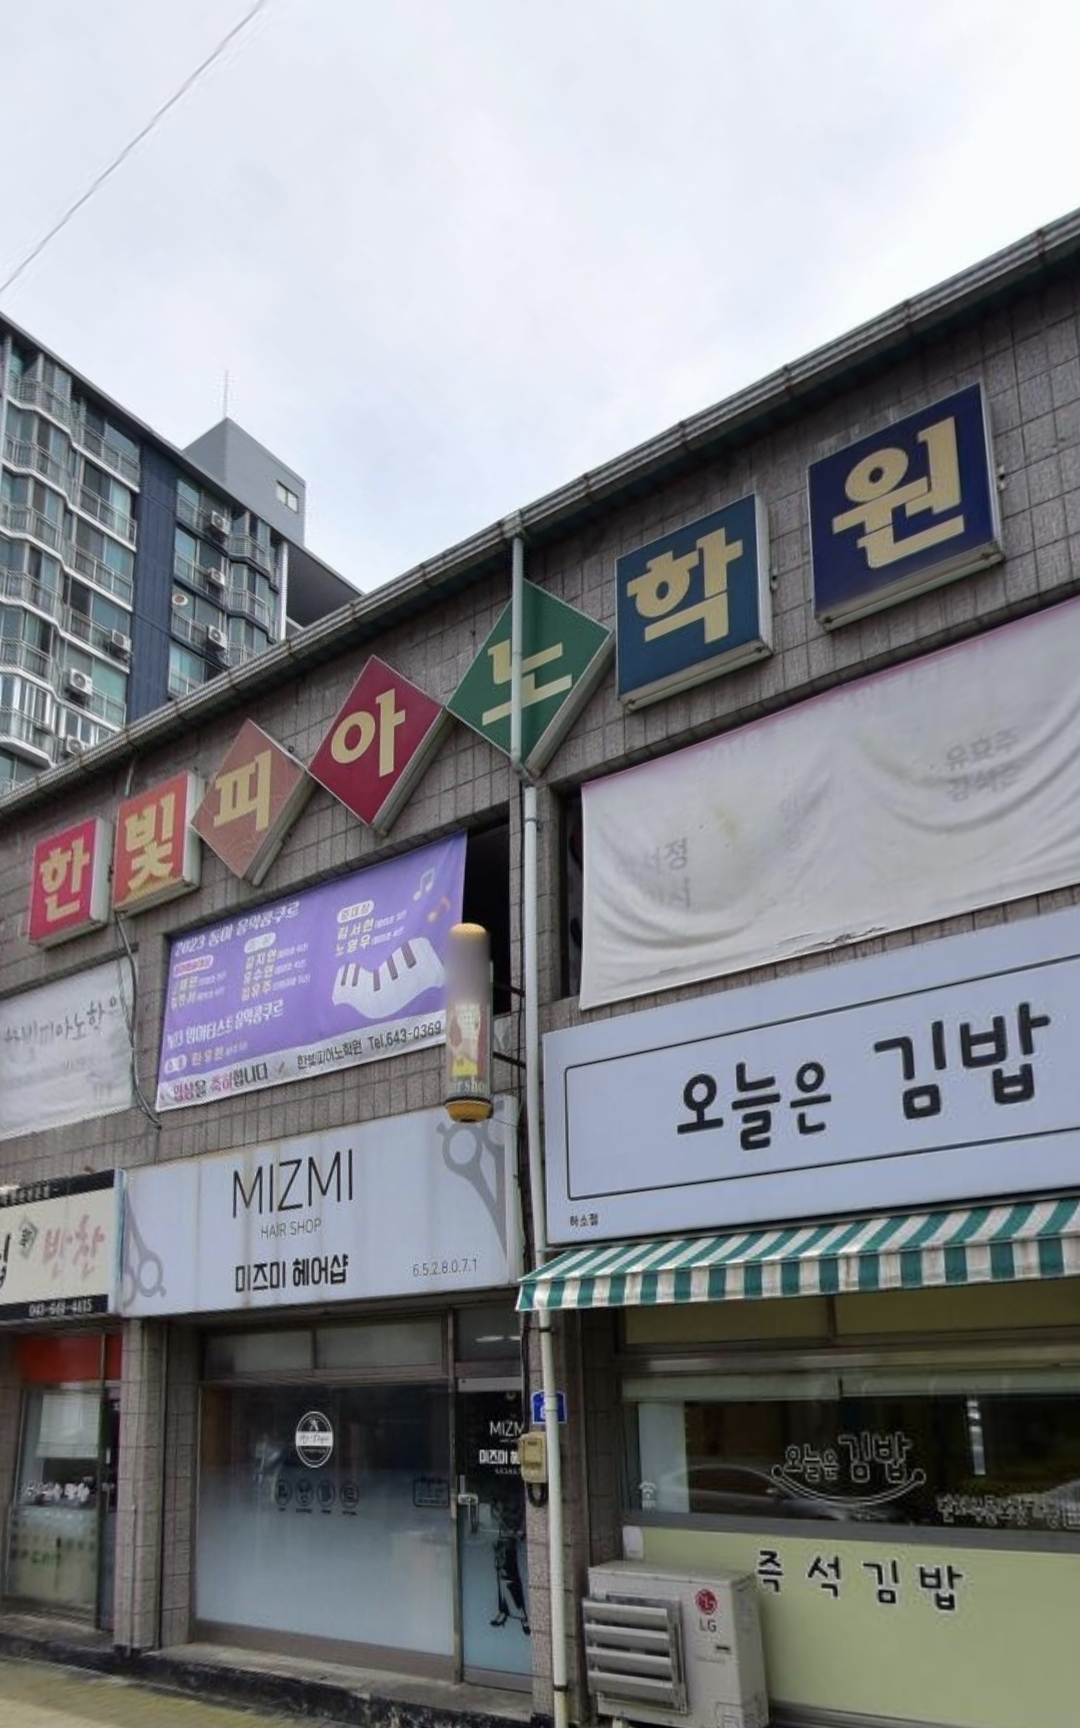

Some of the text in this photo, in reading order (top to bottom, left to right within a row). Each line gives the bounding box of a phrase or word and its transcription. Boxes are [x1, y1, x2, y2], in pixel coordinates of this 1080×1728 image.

[676, 1001, 1052, 1151] 오늘은 김밥
[231, 1147, 353, 1219] MIZMI
[260, 1217, 322, 1238] HAIR SHOP
[235, 1252, 349, 1293] 미즈미 헤어샵
